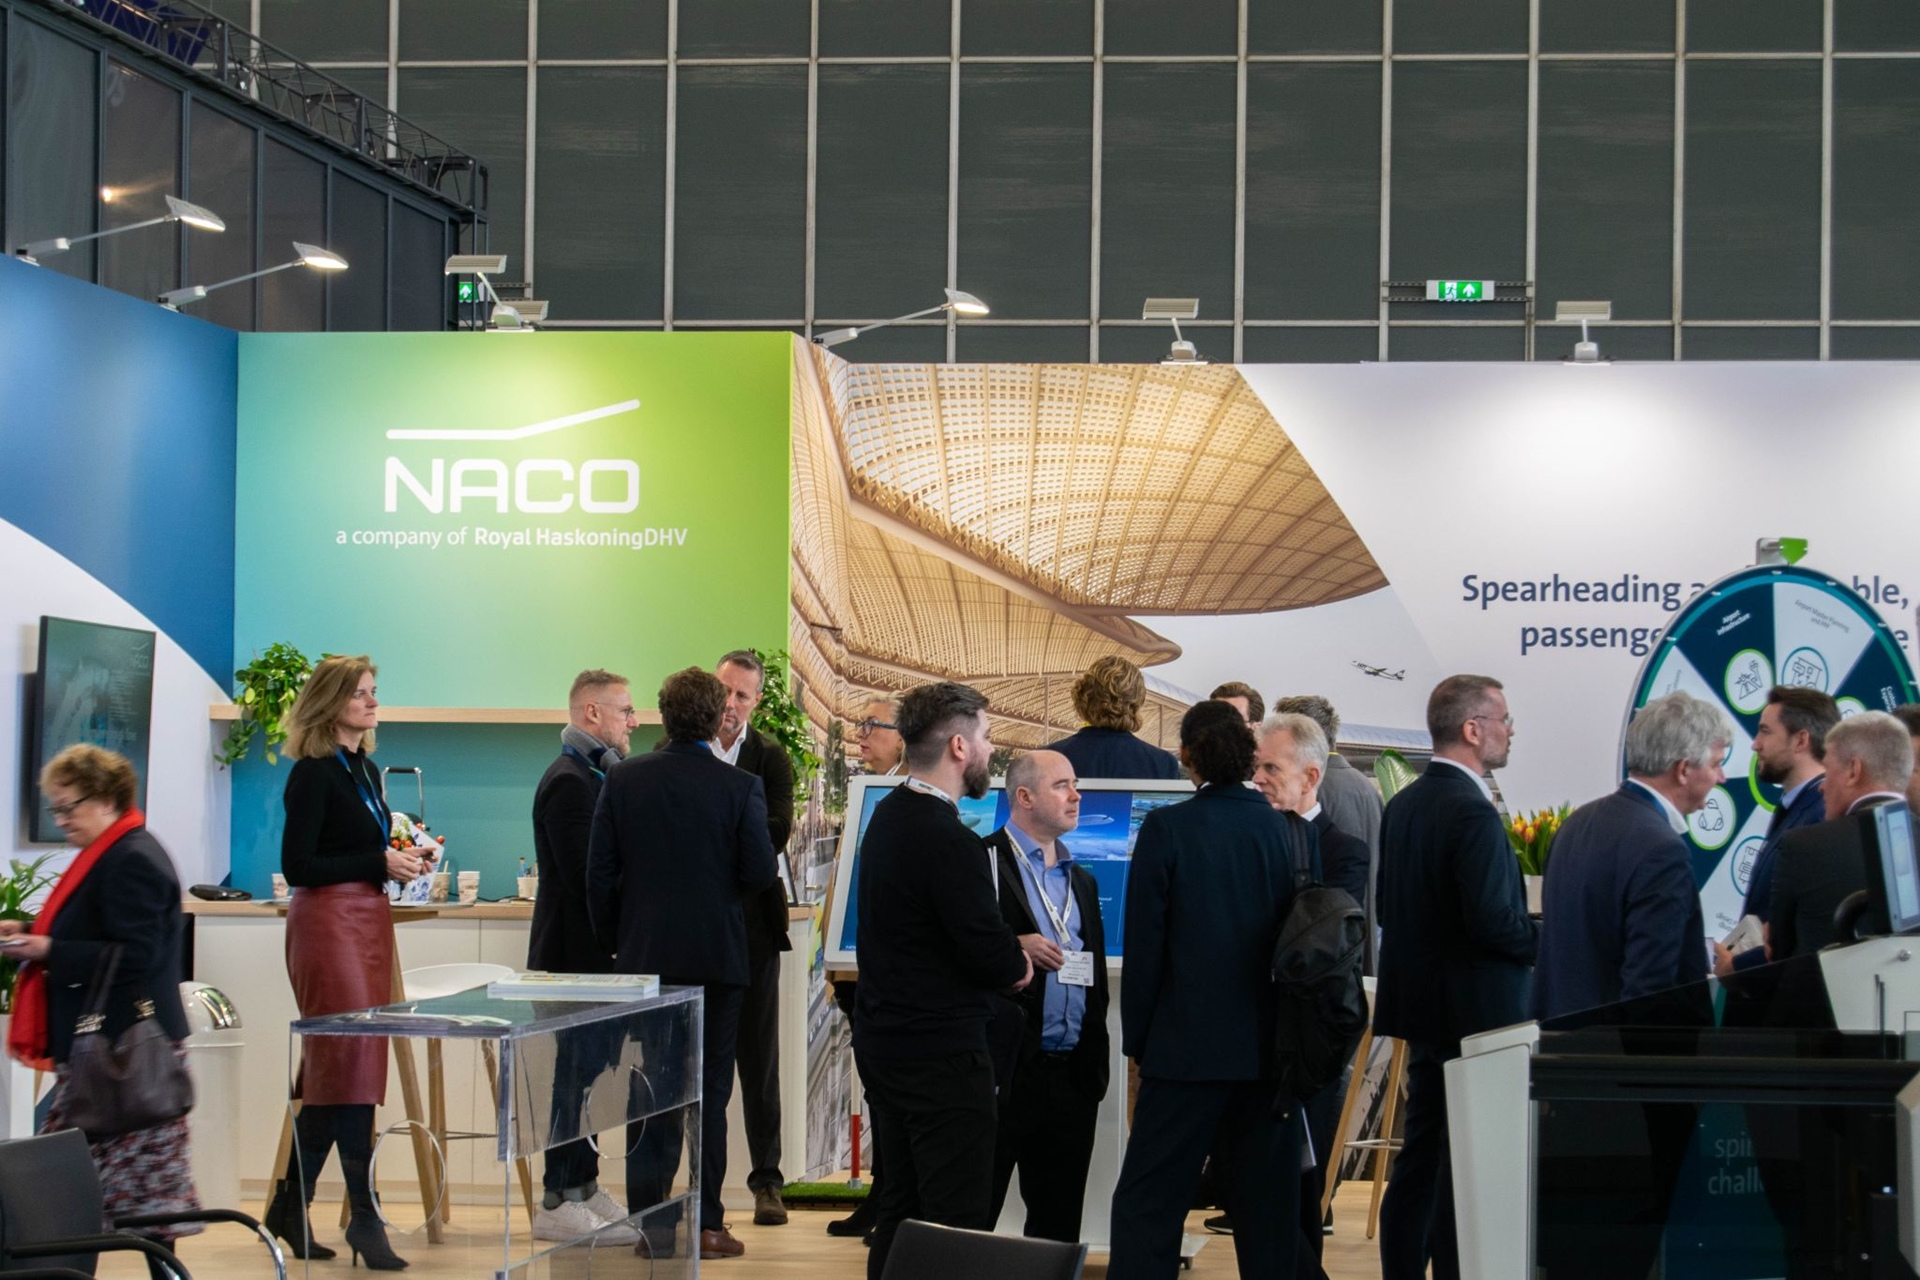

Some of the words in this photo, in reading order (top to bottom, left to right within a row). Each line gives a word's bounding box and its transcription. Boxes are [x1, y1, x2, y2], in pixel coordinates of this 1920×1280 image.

[385, 456, 640, 514] NACO
[335, 530, 347, 545] a
[352, 530, 442, 550] company
[447, 526, 469, 545] of
[475, 527, 531, 550] Royal
[536, 528, 688, 550] HaskoningDHV
[1462, 573, 1682, 612] Spearheading
